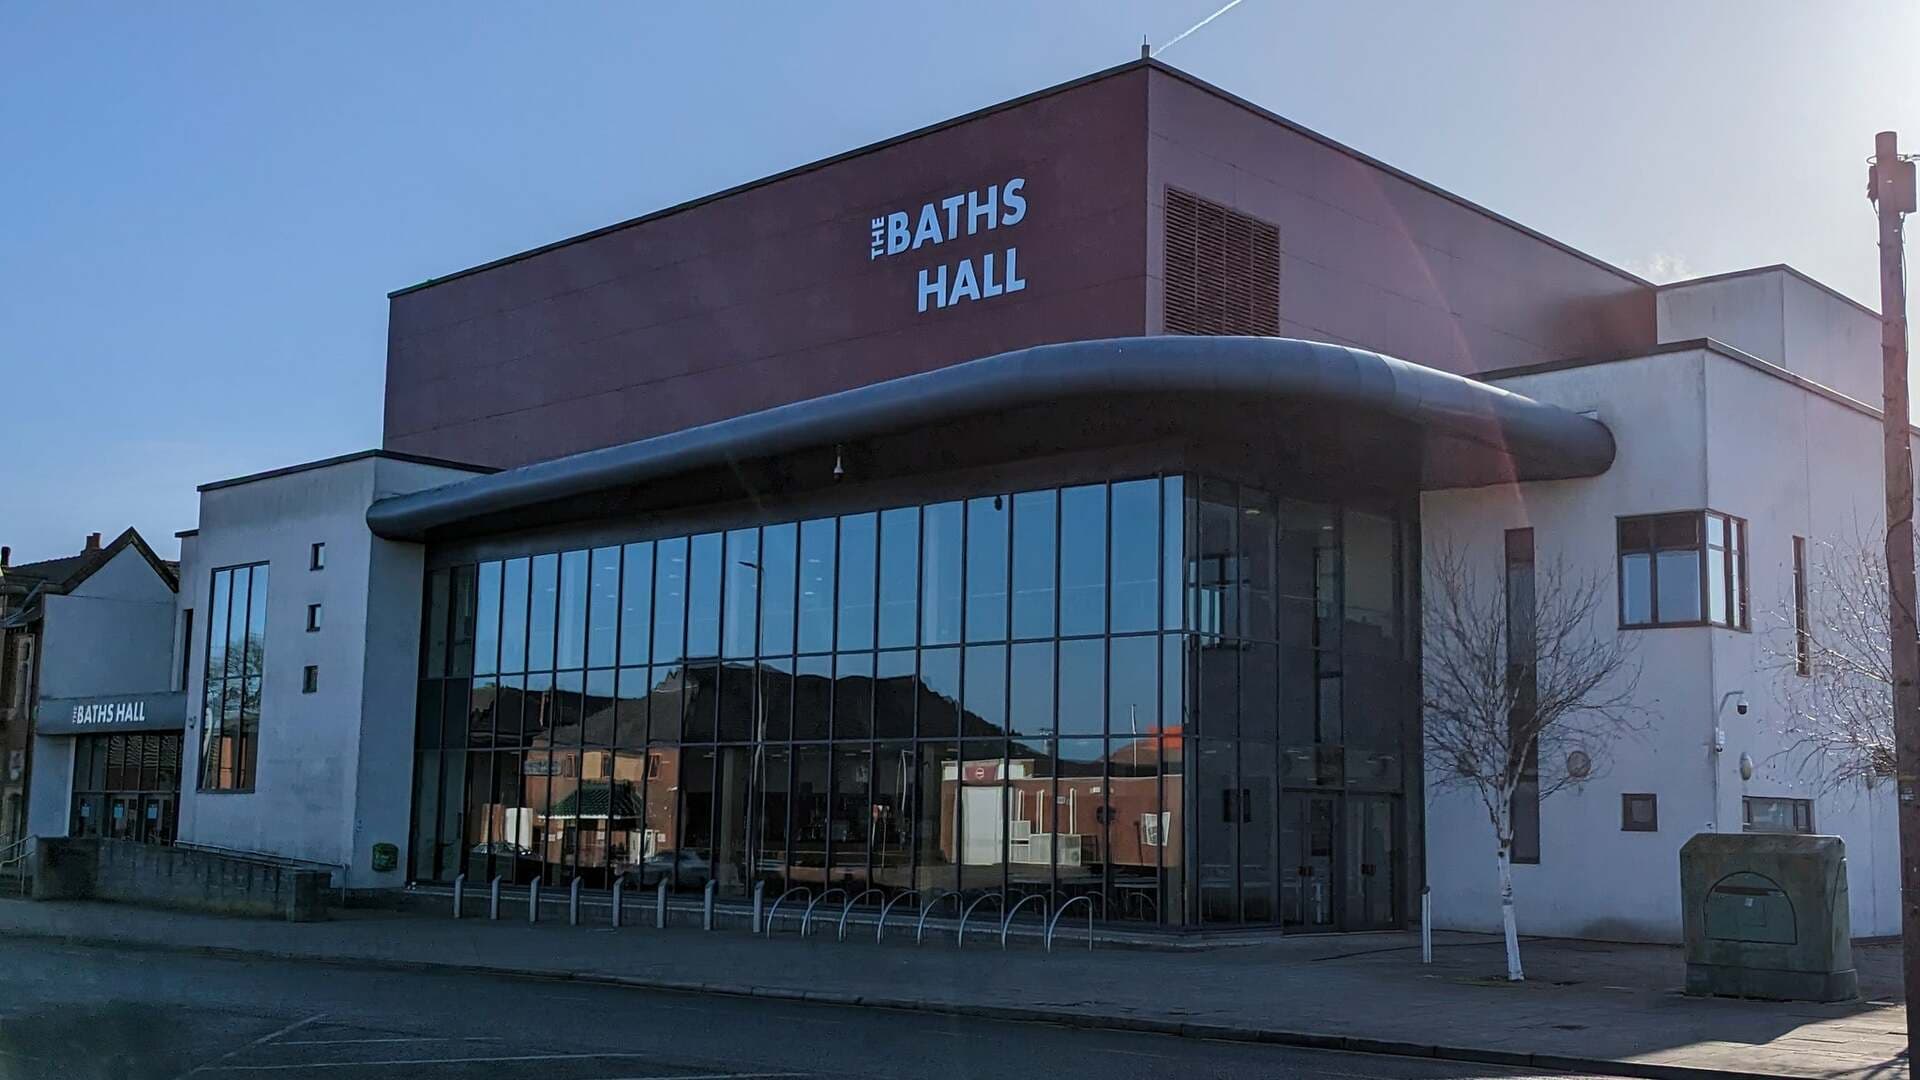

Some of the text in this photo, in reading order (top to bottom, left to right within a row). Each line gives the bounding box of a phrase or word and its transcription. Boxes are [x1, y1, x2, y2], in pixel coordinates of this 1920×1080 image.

[871, 178, 1027, 261] THE BATHS
[918, 247, 1026, 313] HALL
[77, 703, 114, 724] BATHS
[115, 701, 145, 722] HALL
